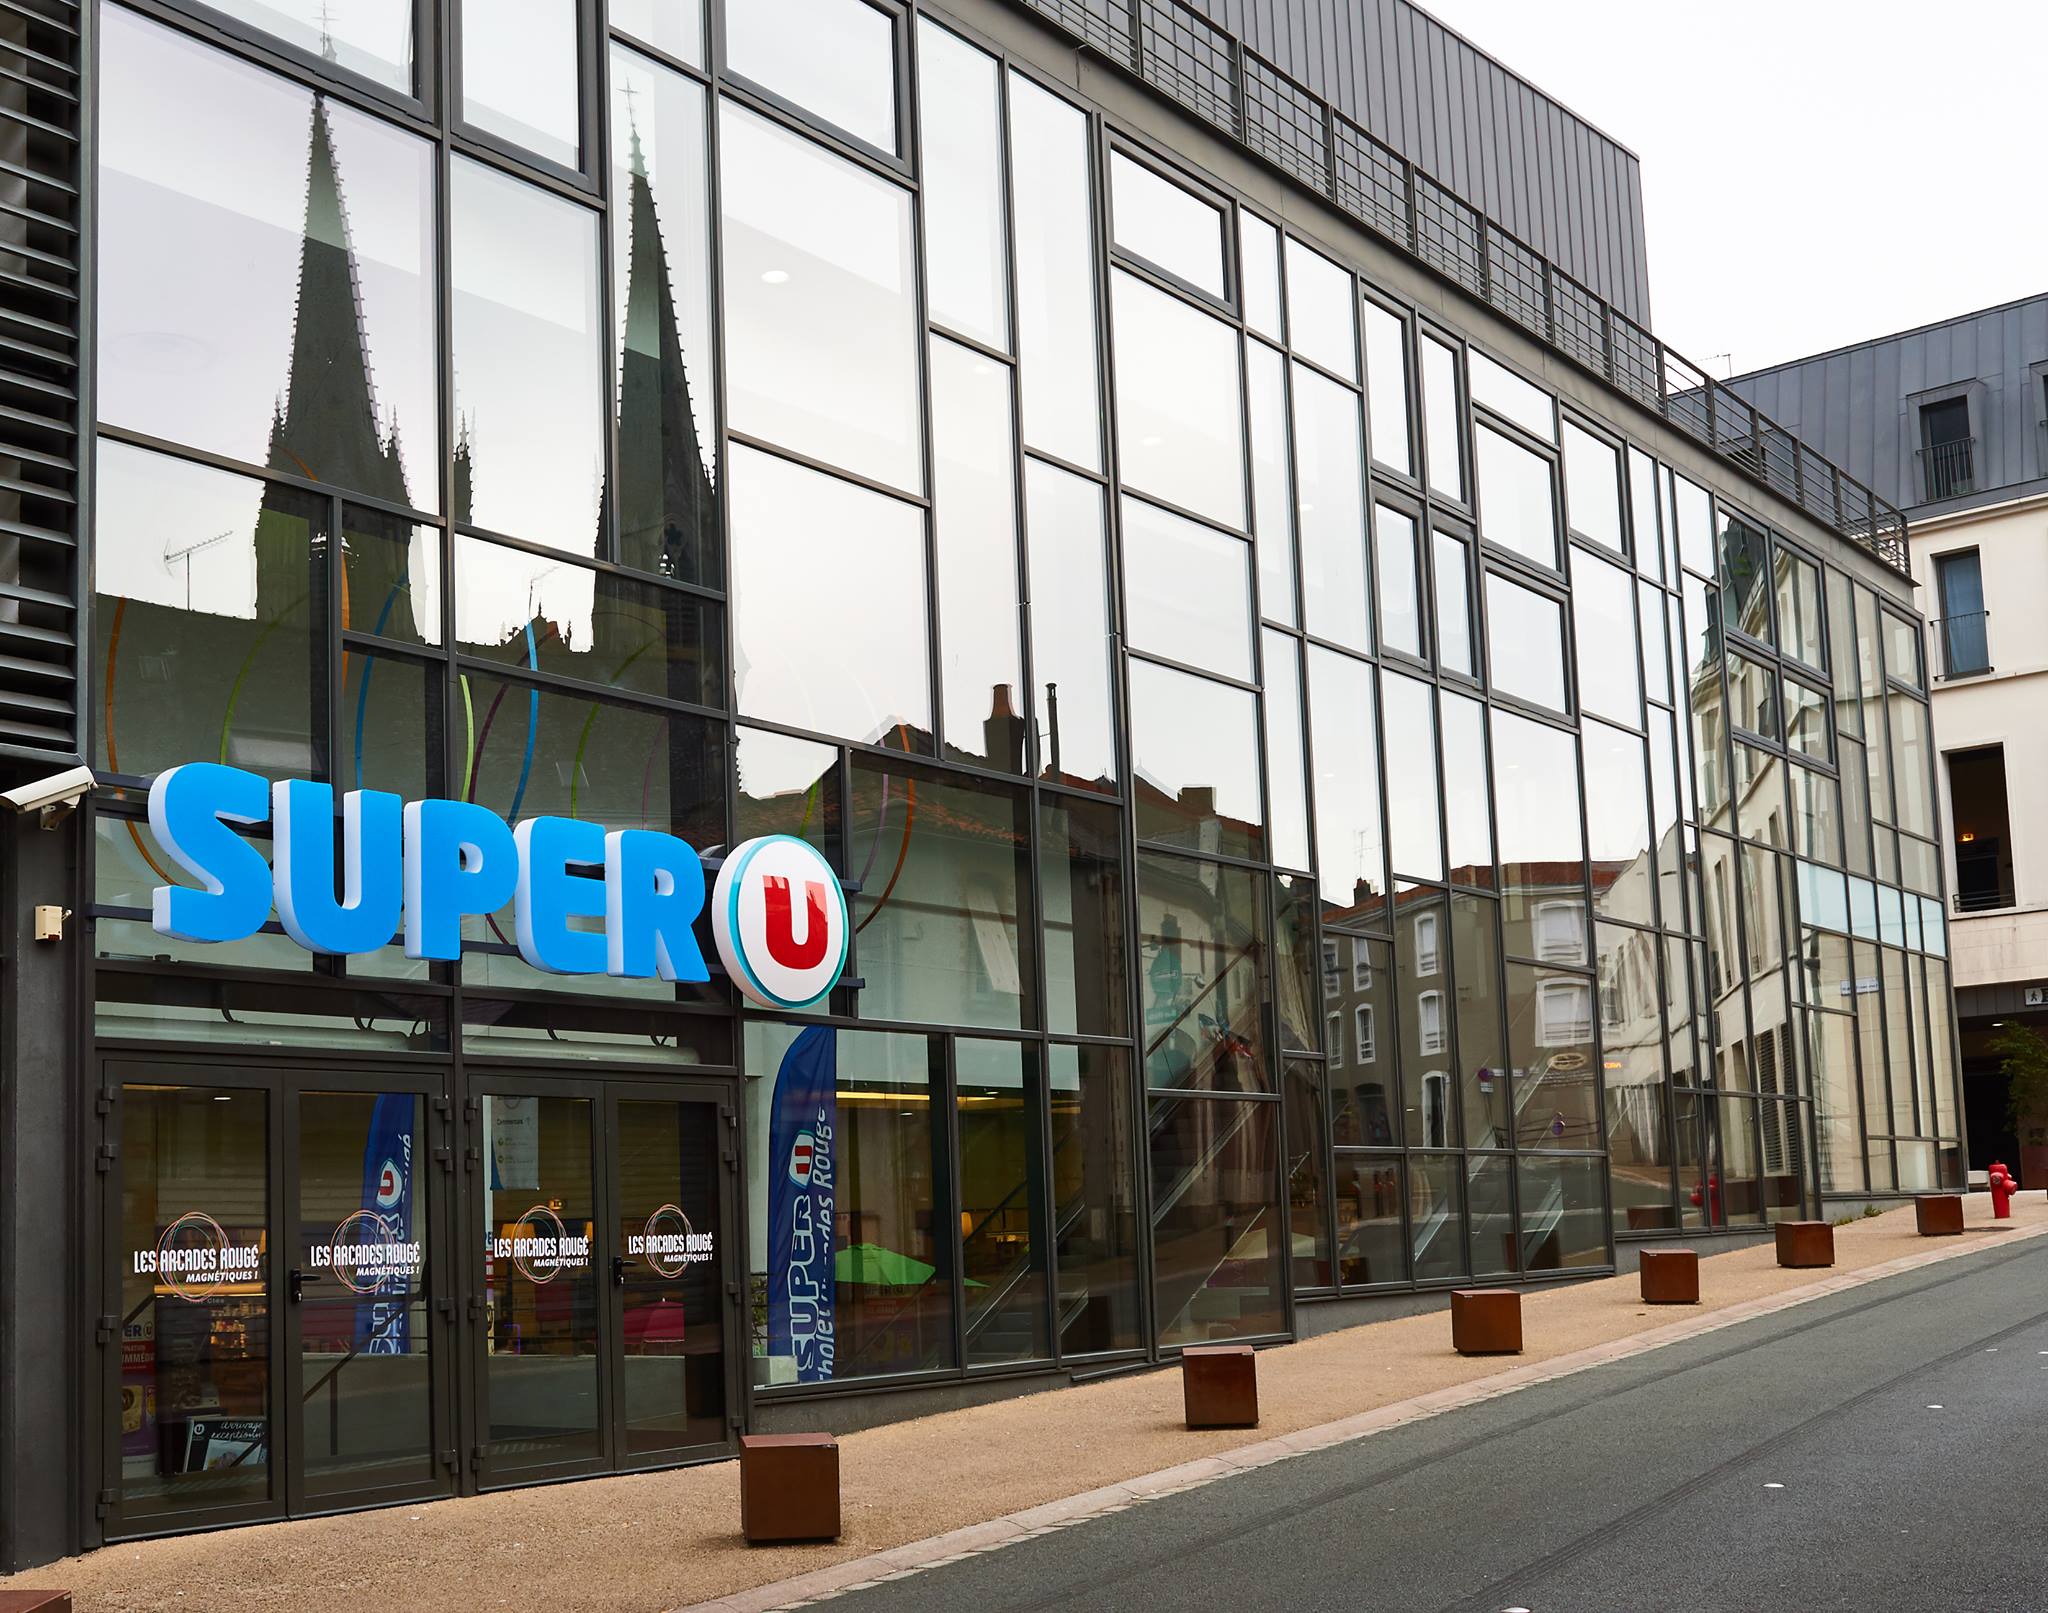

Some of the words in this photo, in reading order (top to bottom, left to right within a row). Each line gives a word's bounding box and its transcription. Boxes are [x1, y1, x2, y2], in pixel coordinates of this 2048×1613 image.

[148, 762, 711, 984] SUPER
[311, 1245, 331, 1267] LES
[333, 1244, 383, 1266] ARCADES
[386, 1241, 420, 1264] ROUGÉ
[494, 1238, 512, 1258] LES
[514, 1237, 557, 1257] ARCADES
[559, 1235, 589, 1256] ROUGÉ
[628, 1235, 645, 1254] LES
[646, 1234, 685, 1254] ARCADES
[686, 1232, 713, 1252] ROUGÉ
[134, 1250, 157, 1273] LES
[160, 1248, 217, 1272] ARCADES
[220, 1244, 259, 1270] ROUGÉ
[533, 1257, 584, 1268] MAGNÉTIQUES
[663, 1253, 709, 1263] MAGNÉTIQUES
[185, 1271, 253, 1282] MAGNÉTIQUES
[356, 1265, 415, 1277] MAGNÉTIQUES
[787, 1195, 819, 1372] SUPER
